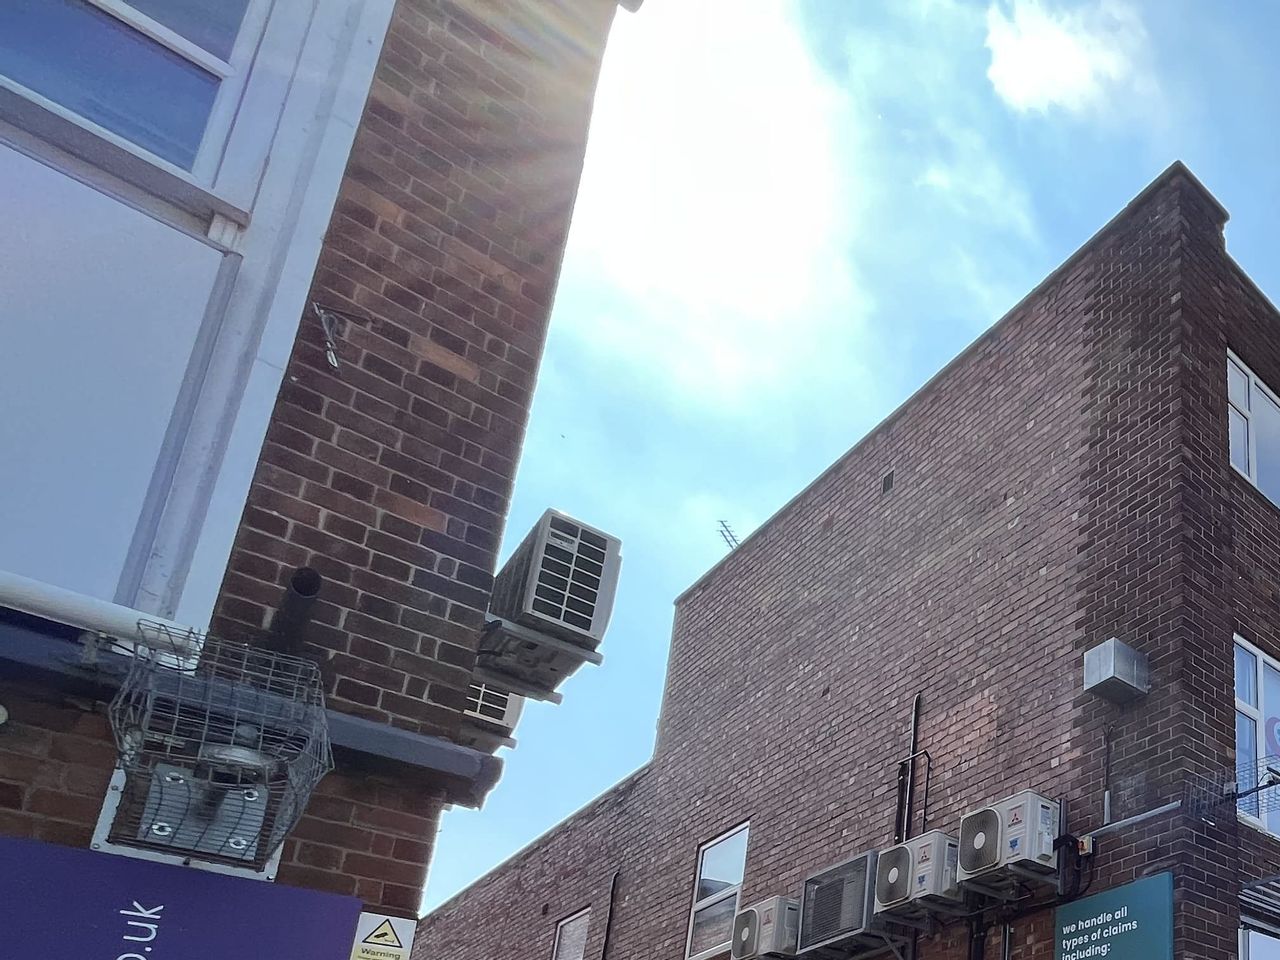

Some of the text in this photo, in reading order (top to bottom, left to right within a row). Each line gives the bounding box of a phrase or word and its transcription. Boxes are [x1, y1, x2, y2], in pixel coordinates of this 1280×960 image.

[1062, 906, 1127, 935] we handle all
[1062, 920, 1138, 951] types of claims
[361, 947, 401, 960] Warning
